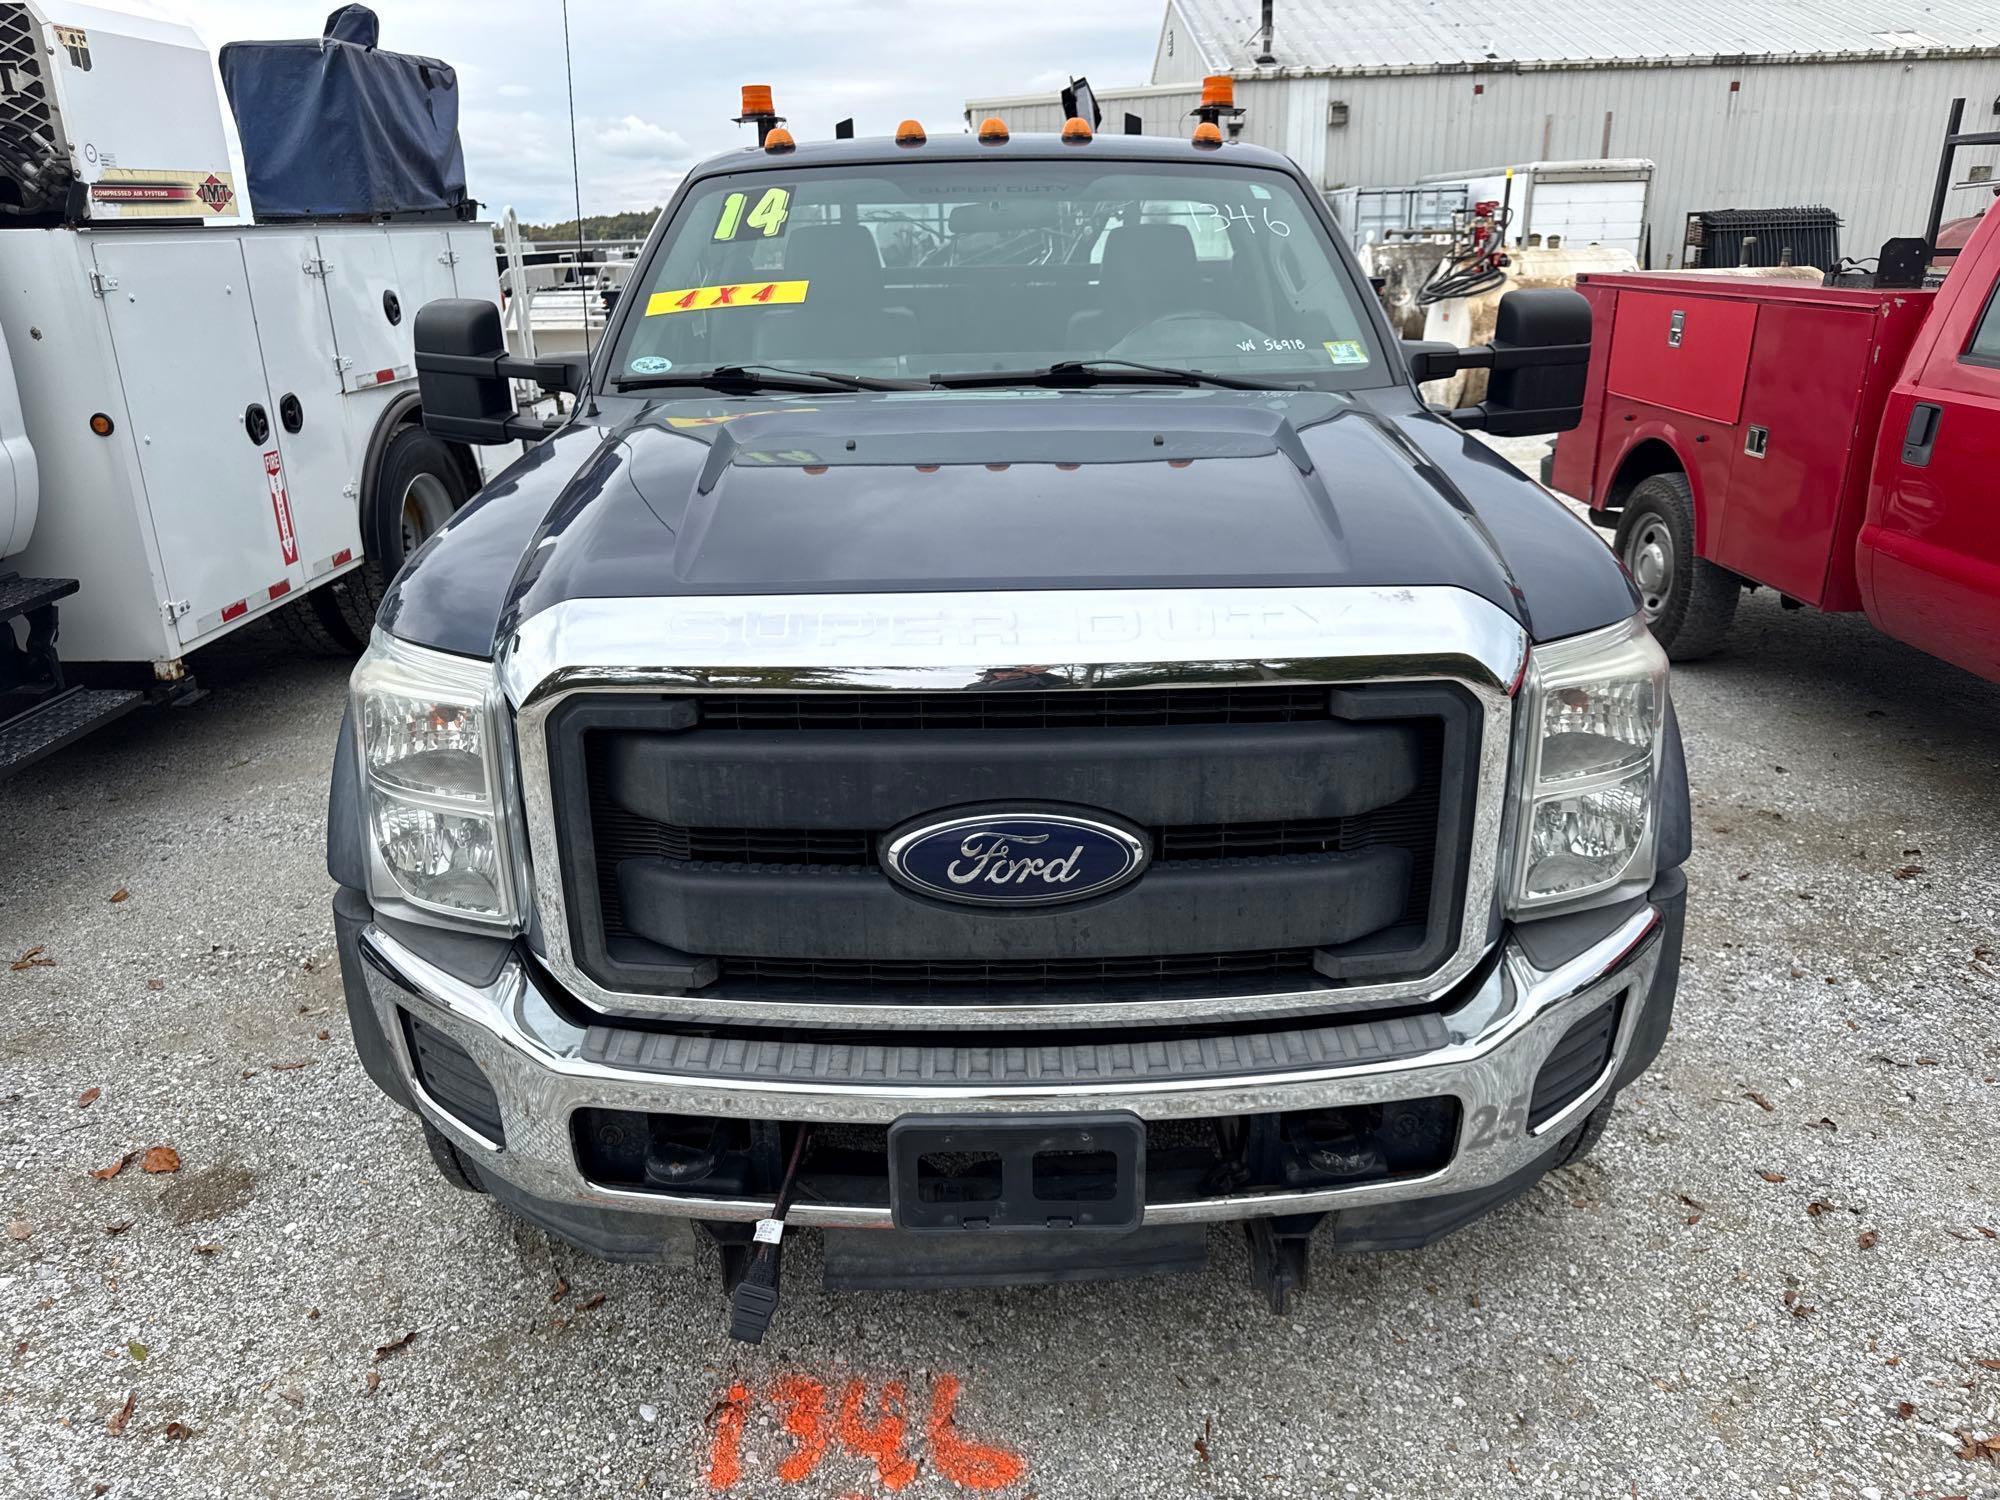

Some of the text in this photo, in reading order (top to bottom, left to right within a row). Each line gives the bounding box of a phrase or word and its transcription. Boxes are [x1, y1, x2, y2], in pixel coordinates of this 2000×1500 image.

[200, 184, 229, 203] IMT
[918, 185, 1070, 194] SUPER DUTY
[713, 187, 790, 241] 14
[1188, 202, 1291, 237] 1346
[265, 454, 279, 471] FIRE
[664, 602, 1353, 650] SUPER DUTY
[946, 831, 1085, 884] Ford
[709, 1374, 1024, 1491] 1346
